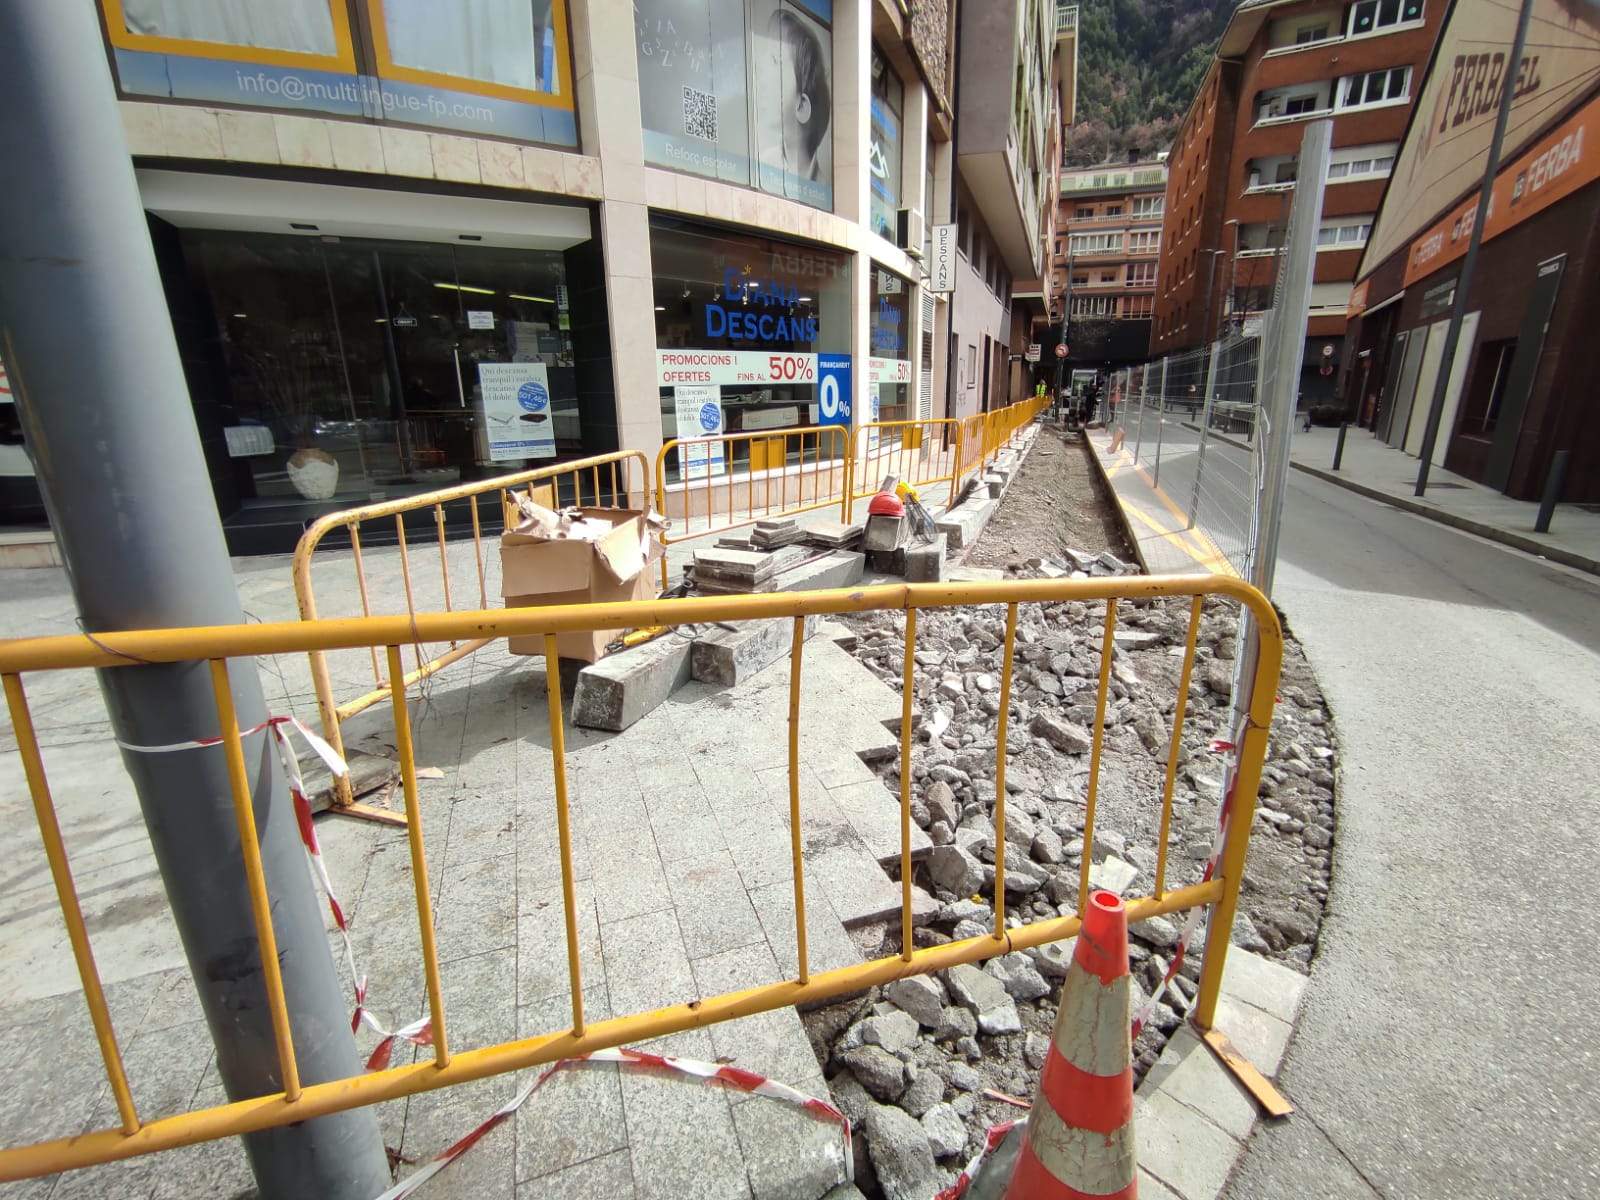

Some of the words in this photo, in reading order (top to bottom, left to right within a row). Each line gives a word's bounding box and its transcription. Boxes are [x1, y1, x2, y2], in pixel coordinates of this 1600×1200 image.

[665, 142, 700, 167] Reforç
[1525, 125, 1584, 194] FERBA
[938, 228, 948, 289] DESCANS
[705, 303, 817, 343] DESCANS
[662, 355, 731, 366] PROMOCIONS
[769, 356, 813, 381] 50%
[663, 371, 711, 382] OFERTES
[737, 373, 755, 381] FINS
